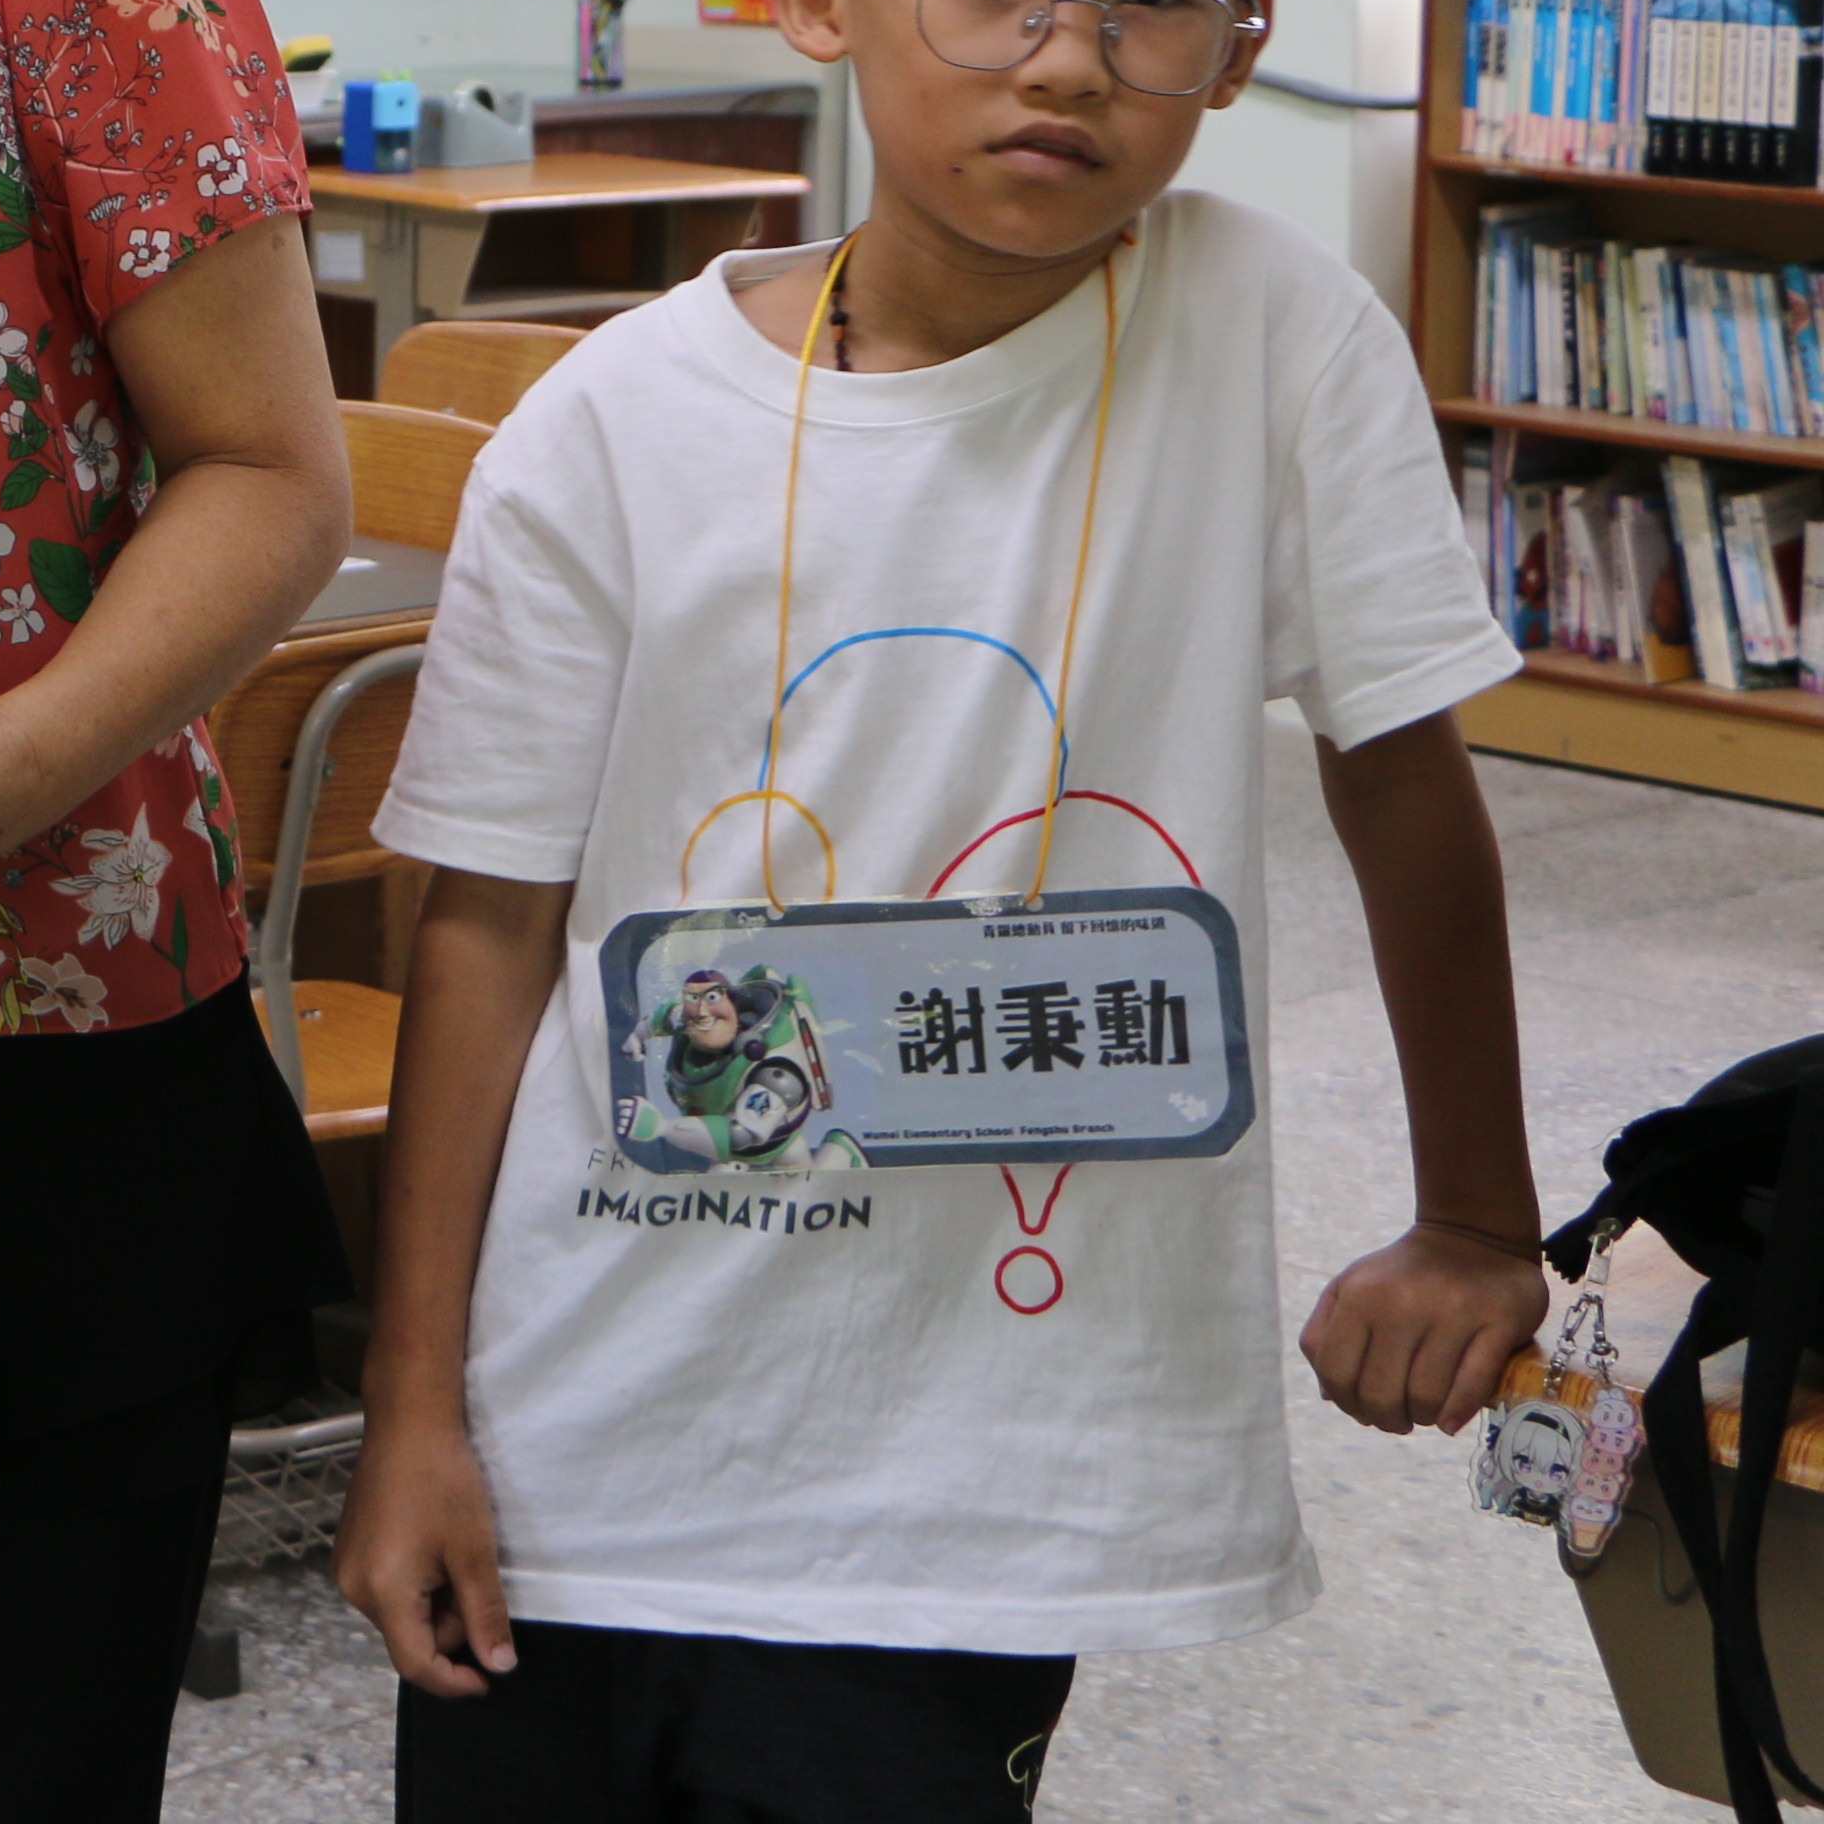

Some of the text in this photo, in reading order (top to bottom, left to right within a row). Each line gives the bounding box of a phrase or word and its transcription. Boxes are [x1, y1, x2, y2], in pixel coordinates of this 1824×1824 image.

[894, 978, 1190, 1076] 謝秉勳
[975, 1126, 1014, 1137] School
[576, 1187, 872, 1234] IMAGINATION
